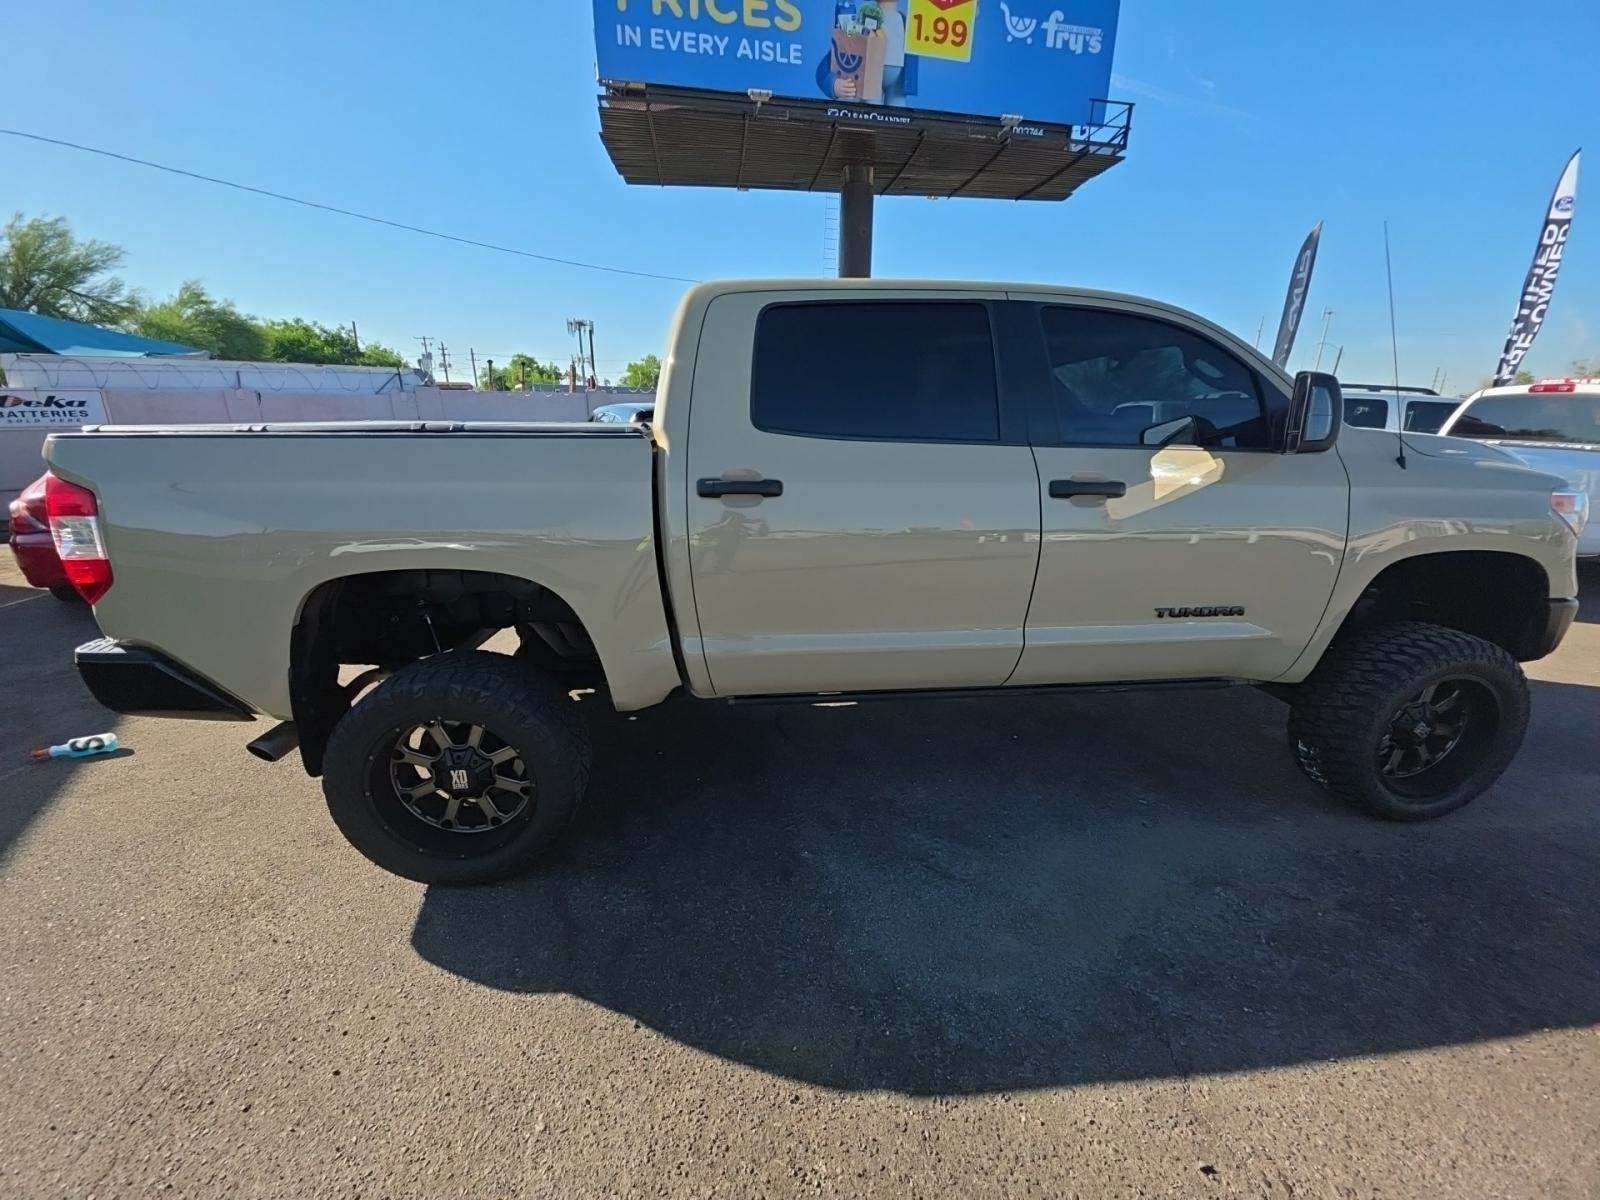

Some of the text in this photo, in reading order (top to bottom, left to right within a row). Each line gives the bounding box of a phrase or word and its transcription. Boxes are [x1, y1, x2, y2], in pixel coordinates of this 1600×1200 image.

[616, 0, 801, 32] CES
[913, 13, 967, 48] 1.99
[1041, 10, 1102, 55] fry's
[616, 23, 803, 64] IN EVERY AISLE
[1154, 606, 1245, 618] TUNDRA
[450, 769, 468, 784] XD
